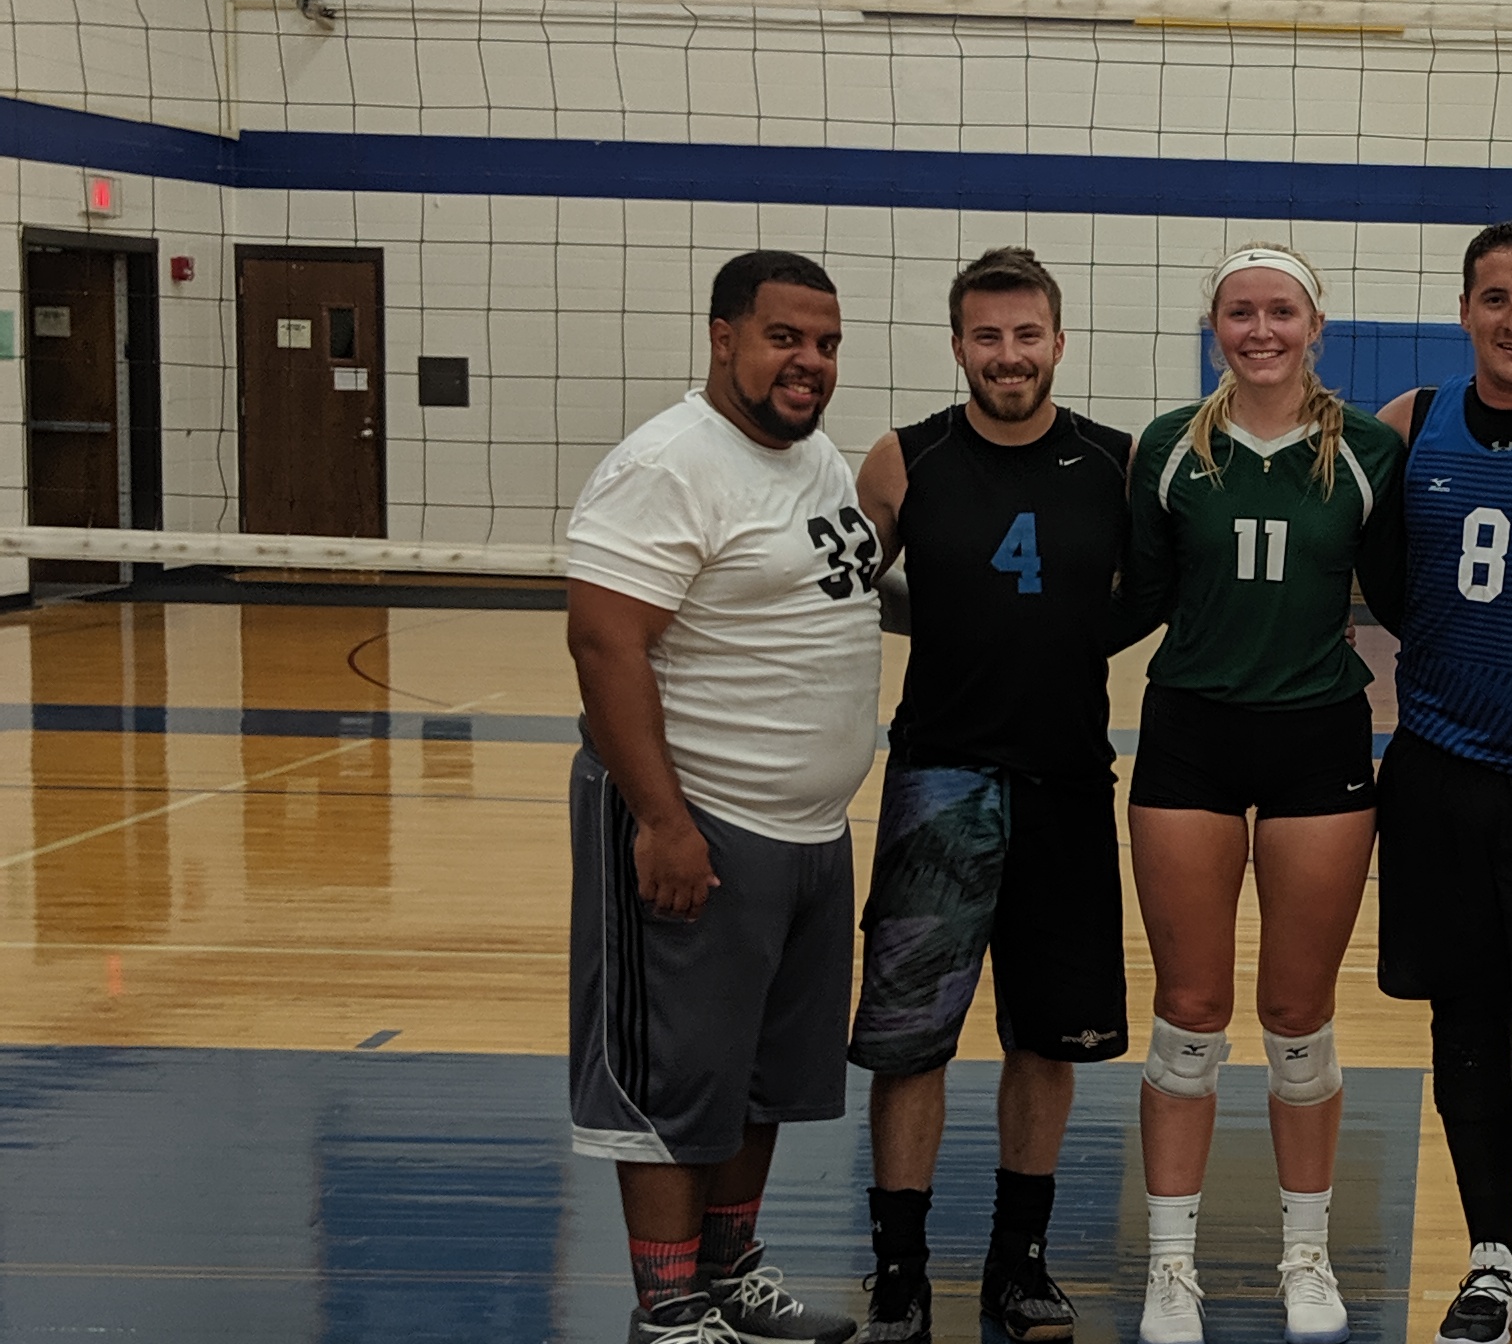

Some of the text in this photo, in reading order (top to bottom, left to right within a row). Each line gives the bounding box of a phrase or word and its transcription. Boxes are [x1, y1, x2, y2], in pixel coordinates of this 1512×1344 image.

[990, 512, 1042, 594] 4
[1234, 518, 1288, 582] 11
[1457, 506, 1511, 603] 8
